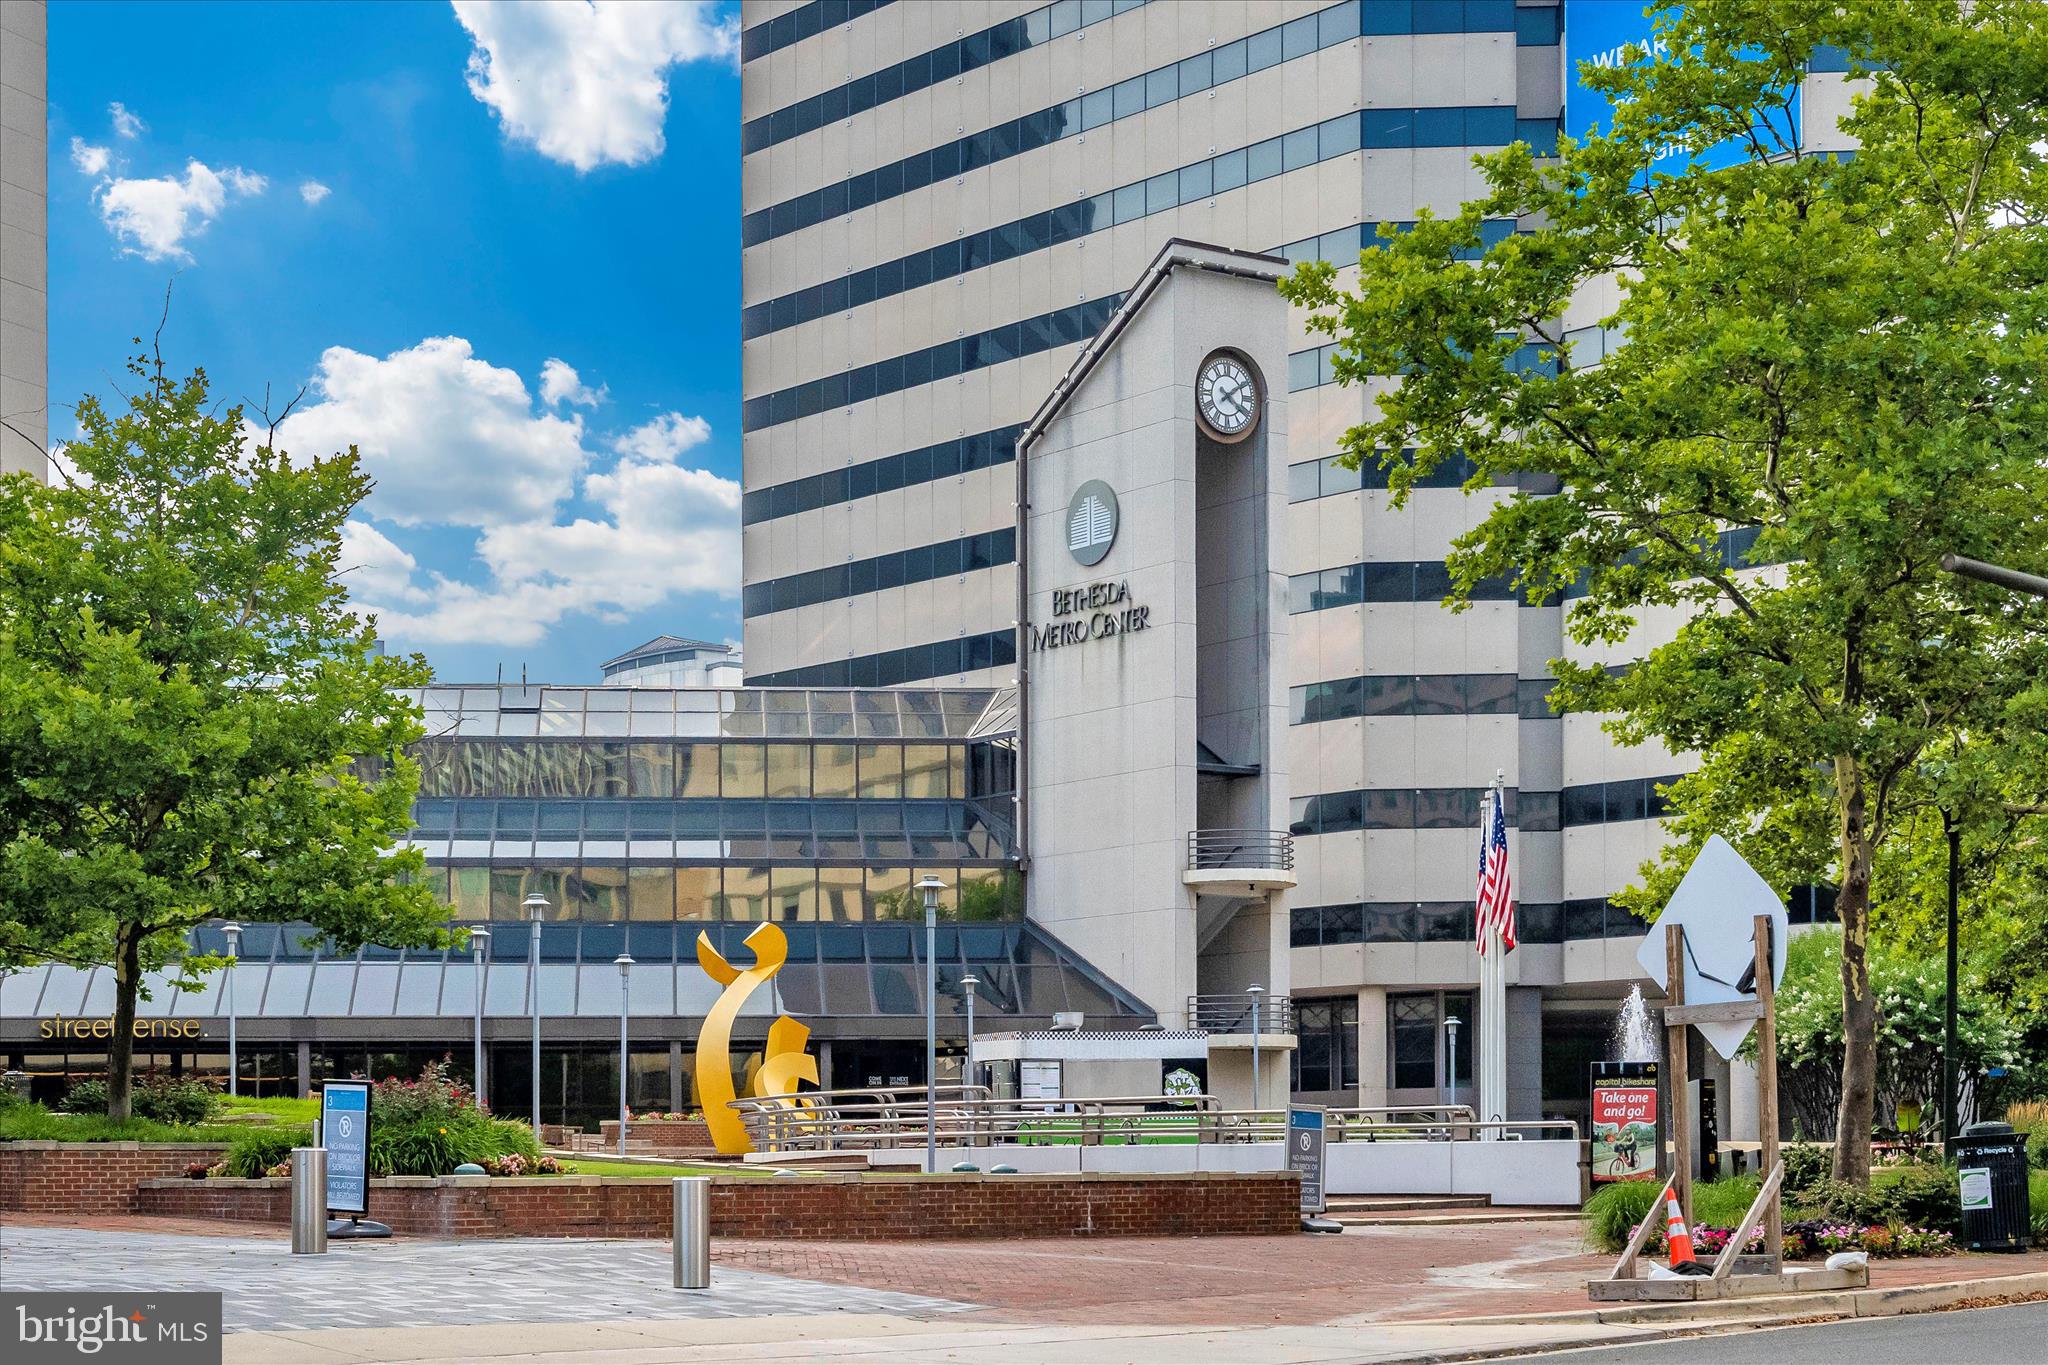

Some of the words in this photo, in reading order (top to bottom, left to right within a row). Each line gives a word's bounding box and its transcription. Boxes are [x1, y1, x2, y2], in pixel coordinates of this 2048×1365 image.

[1052, 578, 1132, 617] BETHESDA
[40, 1013, 209, 1038] streetense.
[1621, 1076, 1656, 1086] bikeshare
[327, 1095, 334, 1107] 3
[1601, 1092, 1627, 1104] Take
[1628, 1094, 1649, 1104] one
[1603, 1105, 1627, 1117] and
[1627, 1105, 1646, 1120] go!
[1291, 1115, 1297, 1125] 3
[329, 1142, 339, 1150] NO
[339, 1143, 361, 1152] PARKING
[1300, 1154, 1318, 1162] PARKING
